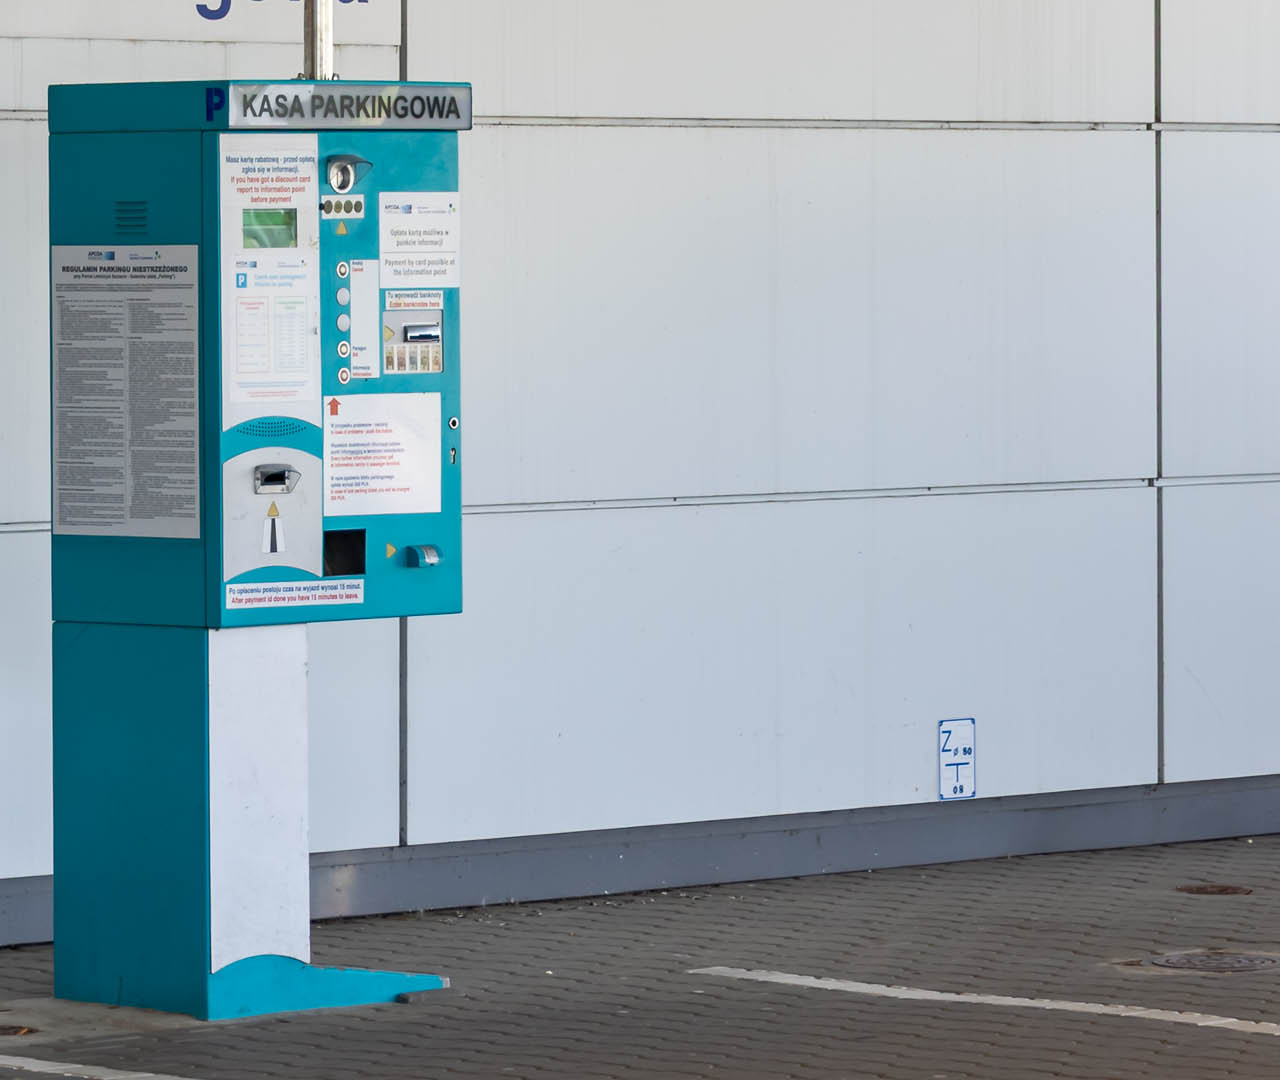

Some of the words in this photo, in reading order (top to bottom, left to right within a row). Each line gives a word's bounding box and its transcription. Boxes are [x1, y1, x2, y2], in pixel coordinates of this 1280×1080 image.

[206, 88, 225, 122] P
[243, 94, 305, 118] KASA
[311, 95, 461, 120] PARKINGOWA
[261, 176, 270, 184] got
[385, 259, 406, 267] Payment
[132, 265, 188, 273] NIESTRZEŻONEGO
[403, 268, 432, 276] information
[433, 268, 447, 277] point
[262, 586, 281, 594] postoju
[245, 596, 266, 604] payment
[941, 730, 952, 752] Z
